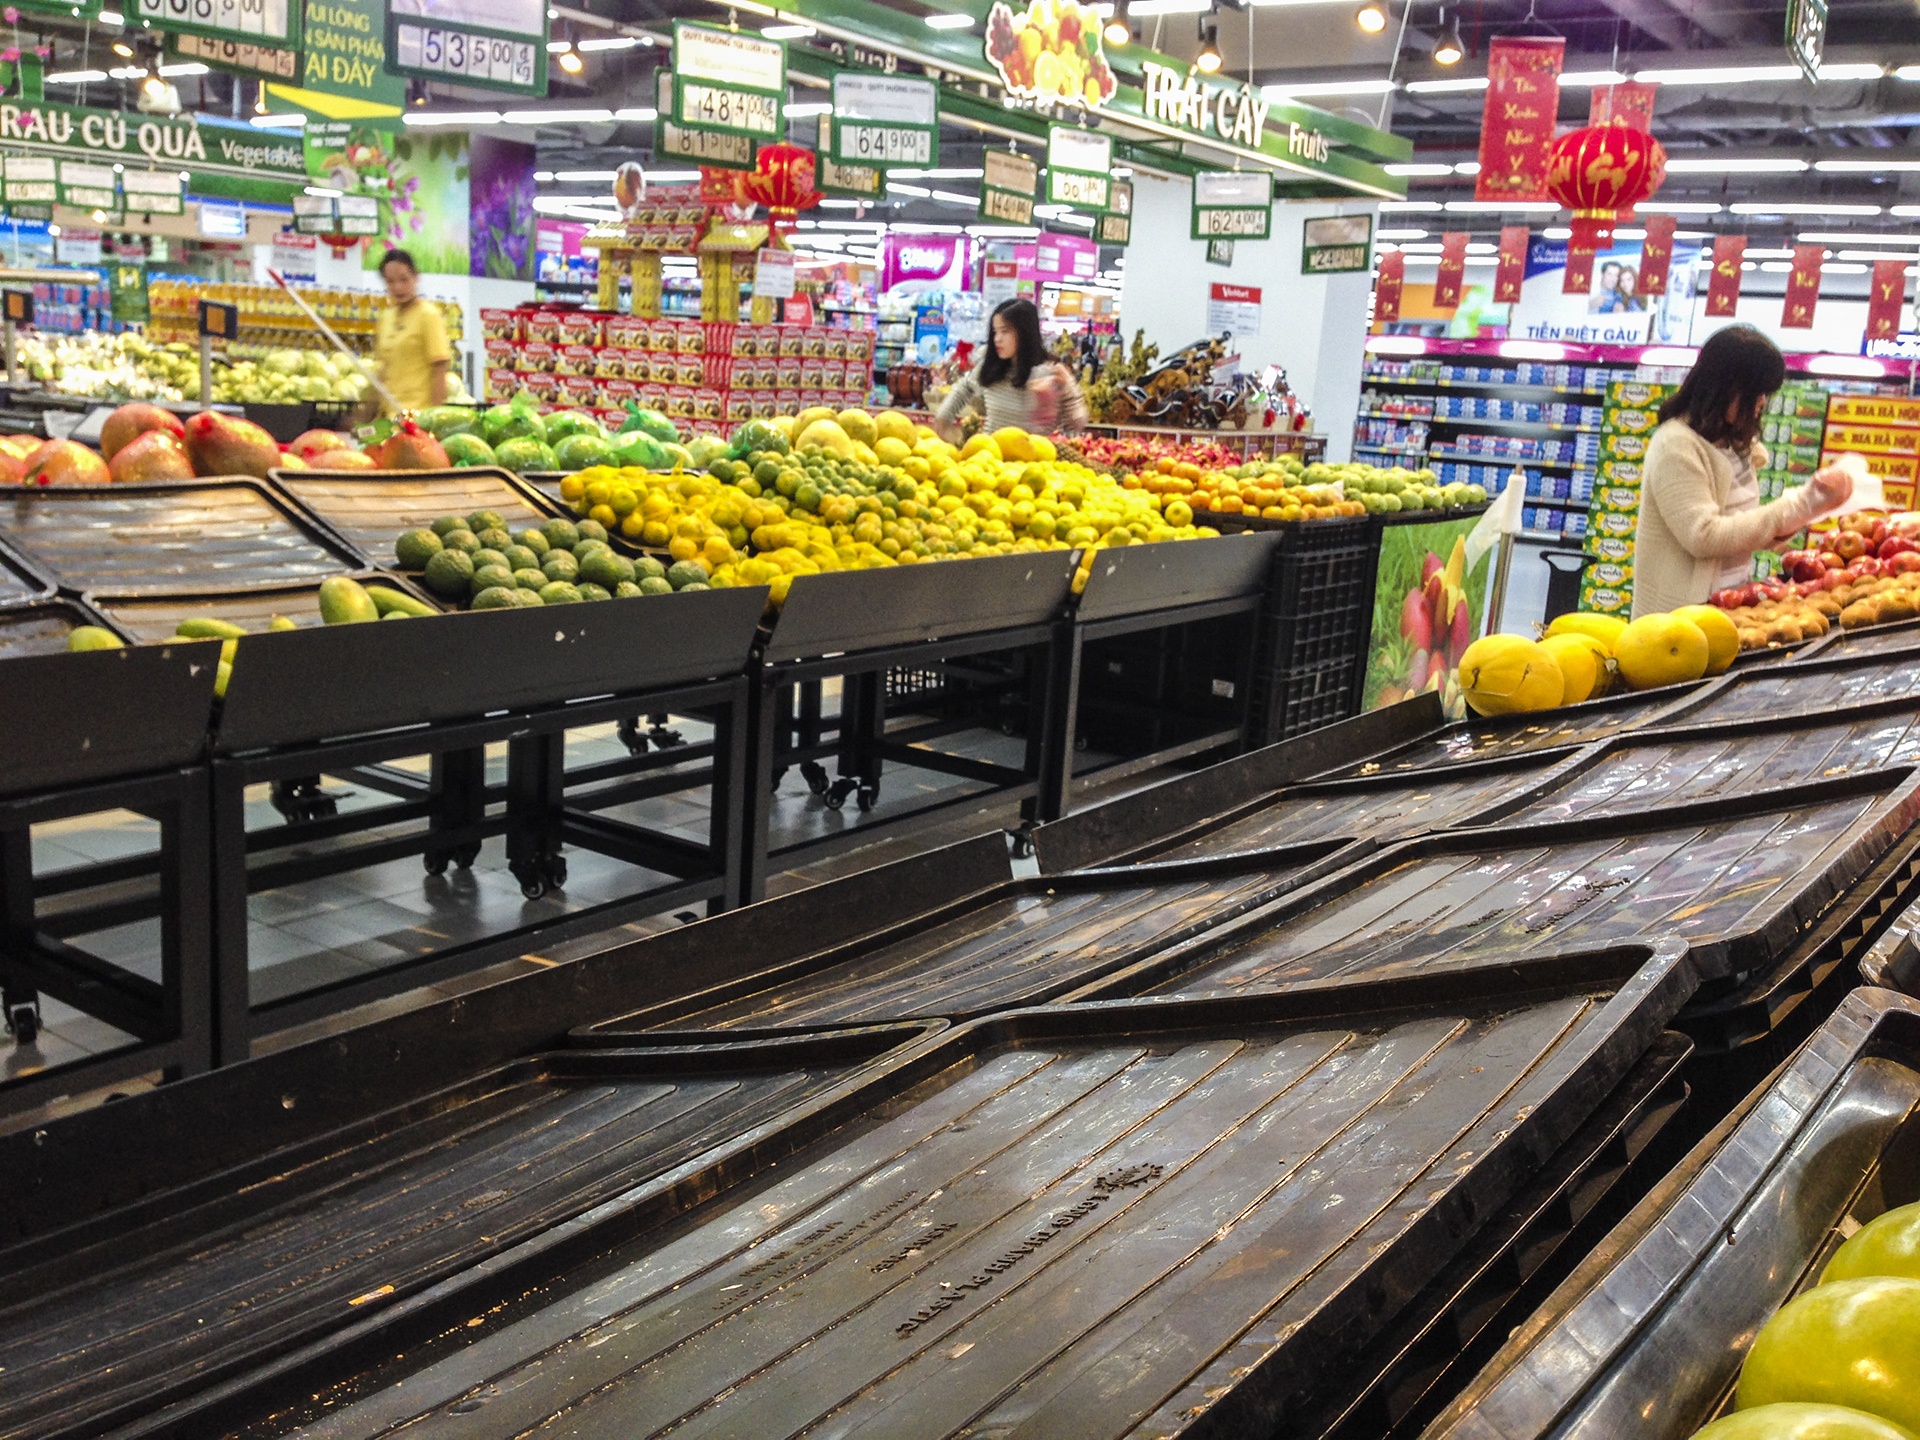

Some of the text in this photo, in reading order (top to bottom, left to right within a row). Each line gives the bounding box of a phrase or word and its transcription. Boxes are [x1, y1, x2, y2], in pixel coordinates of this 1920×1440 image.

[1, 103, 207, 162] RAU CỦ QUẢ
[1142, 60, 1270, 148] TRÁI CÂY
[1288, 121, 1329, 164] Fruits
